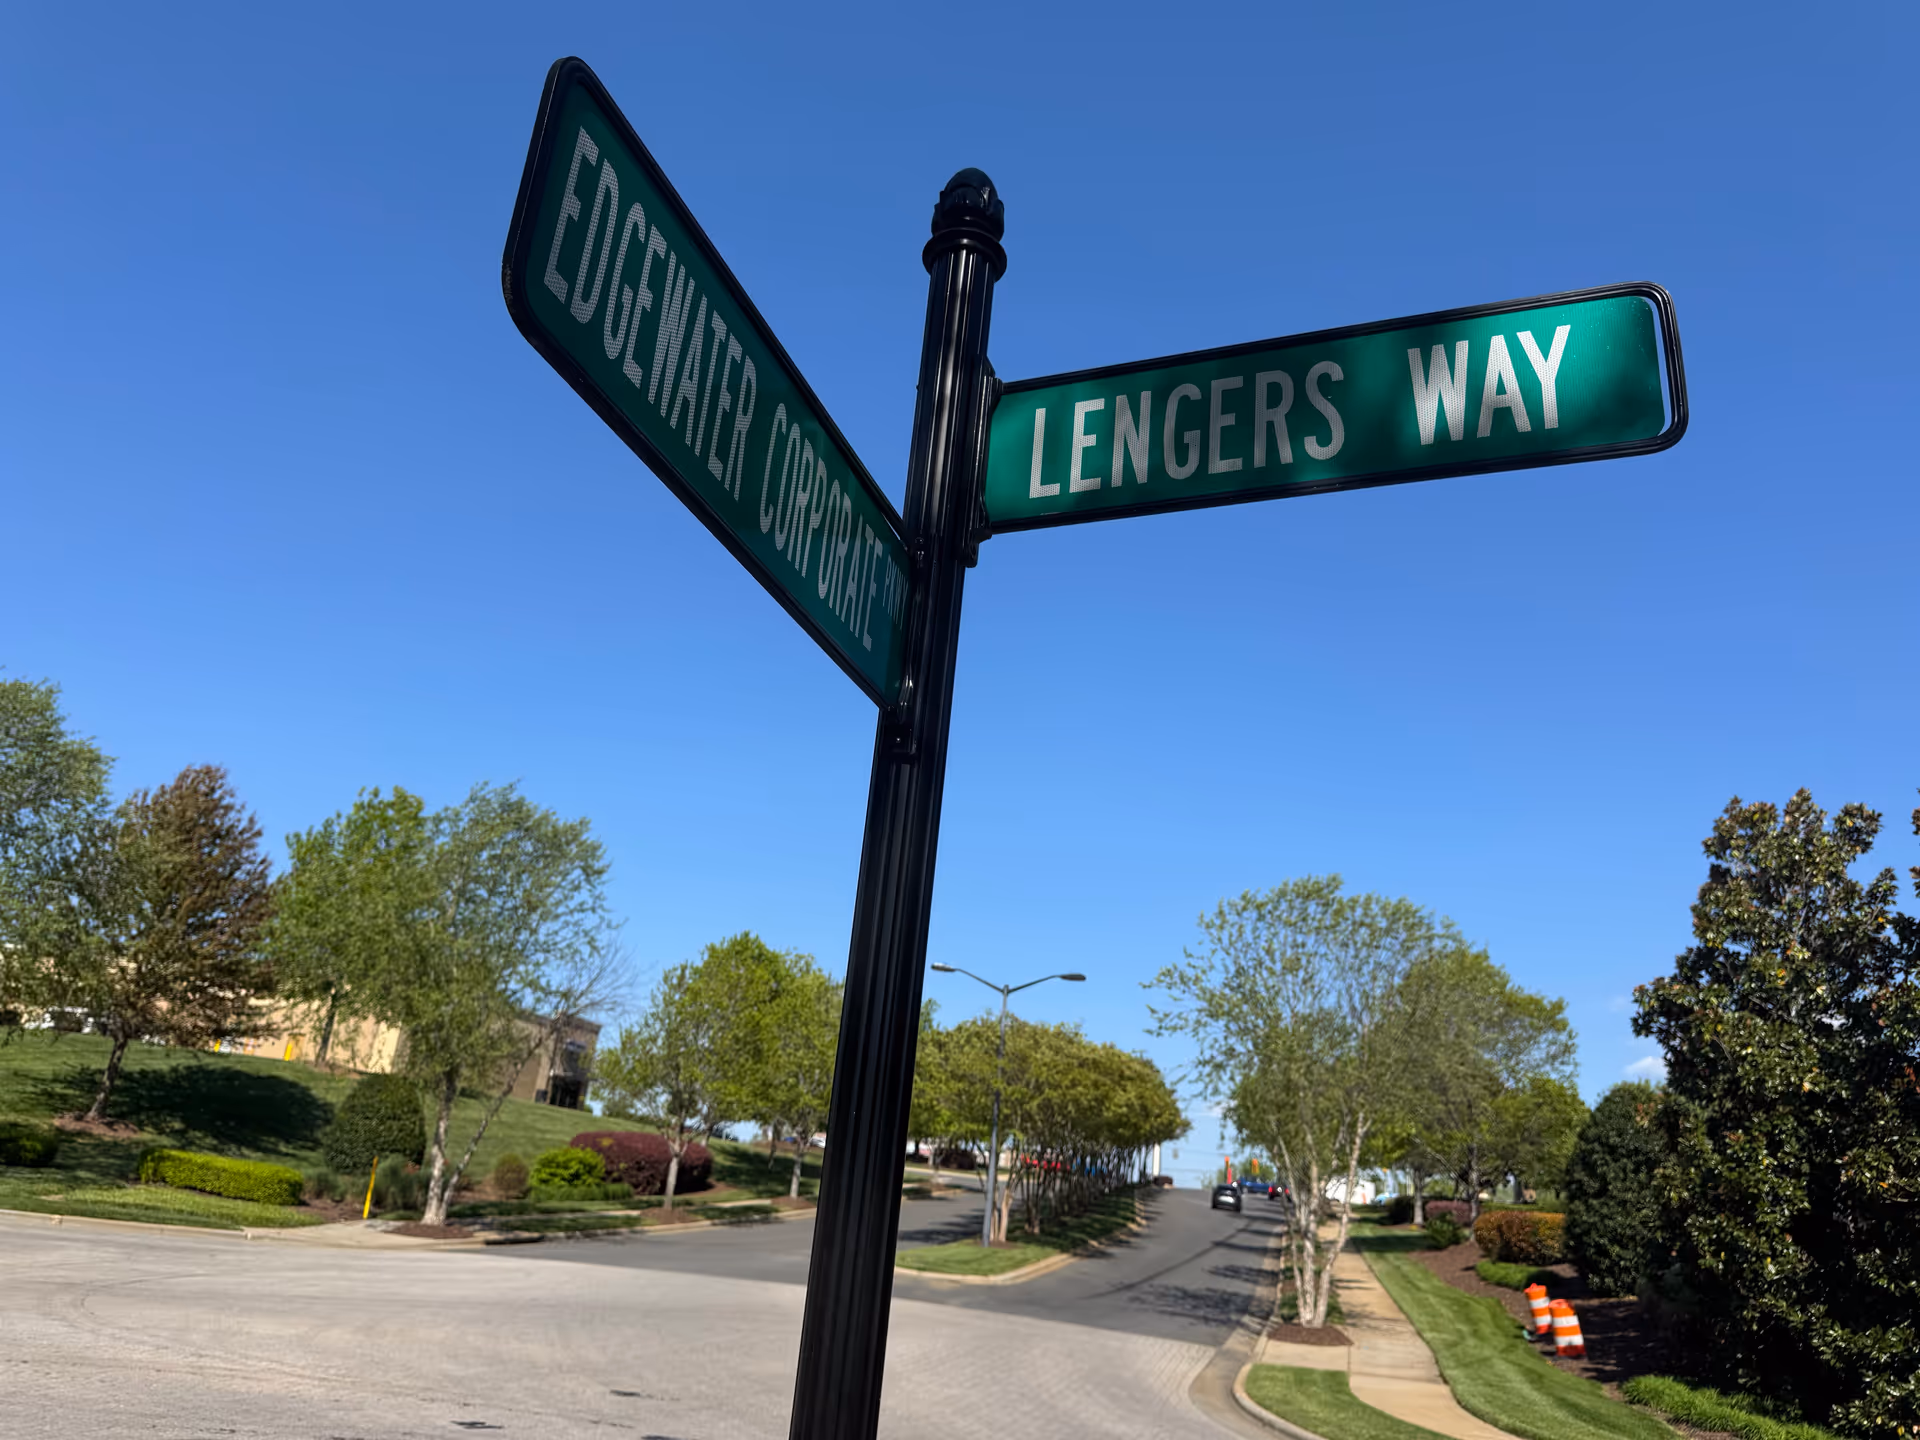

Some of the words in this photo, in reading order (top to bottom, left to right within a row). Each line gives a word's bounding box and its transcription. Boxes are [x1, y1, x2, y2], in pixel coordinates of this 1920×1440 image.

[543, 125, 758, 501] EDGEWATER
[759, 402, 883, 652] CORPORATE
[1029, 360, 1345, 499] LENGERS
[1407, 324, 1571, 445] WAY
